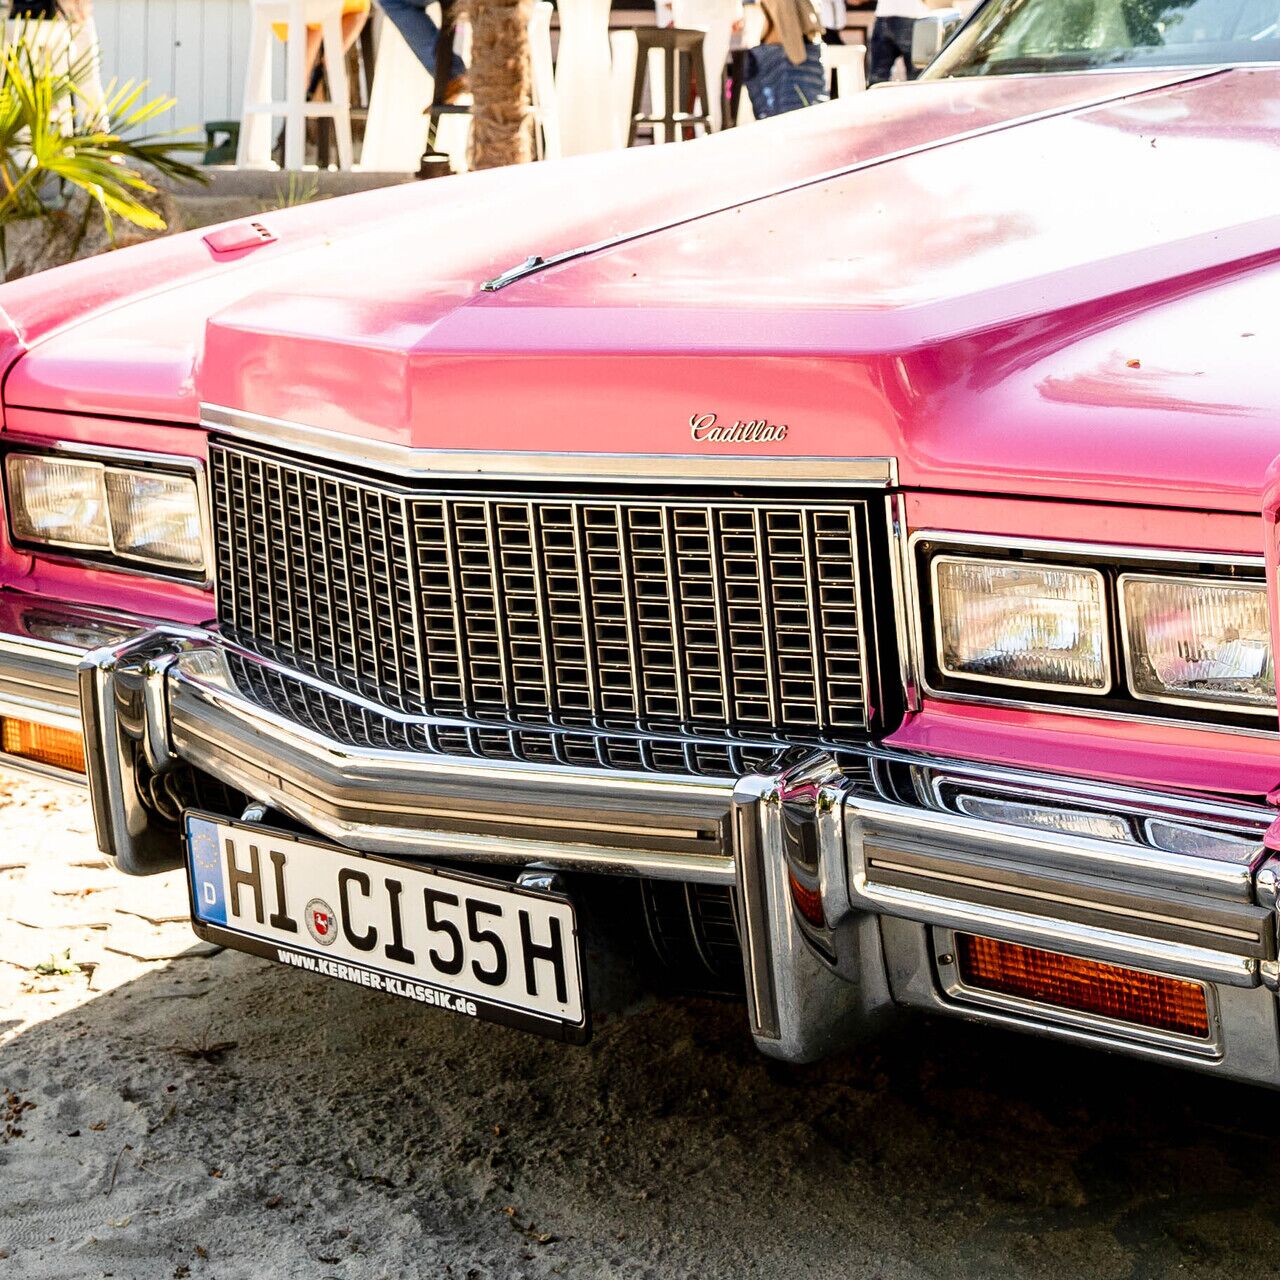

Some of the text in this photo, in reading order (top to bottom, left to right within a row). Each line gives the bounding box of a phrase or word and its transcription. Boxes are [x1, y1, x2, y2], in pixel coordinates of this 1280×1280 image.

[689, 412, 789, 443] Cadillac
[203, 881, 217, 906] D
[225, 838, 299, 934] HI
[276, 948, 478, 1017] www.KERMER-KLASSIK.de
